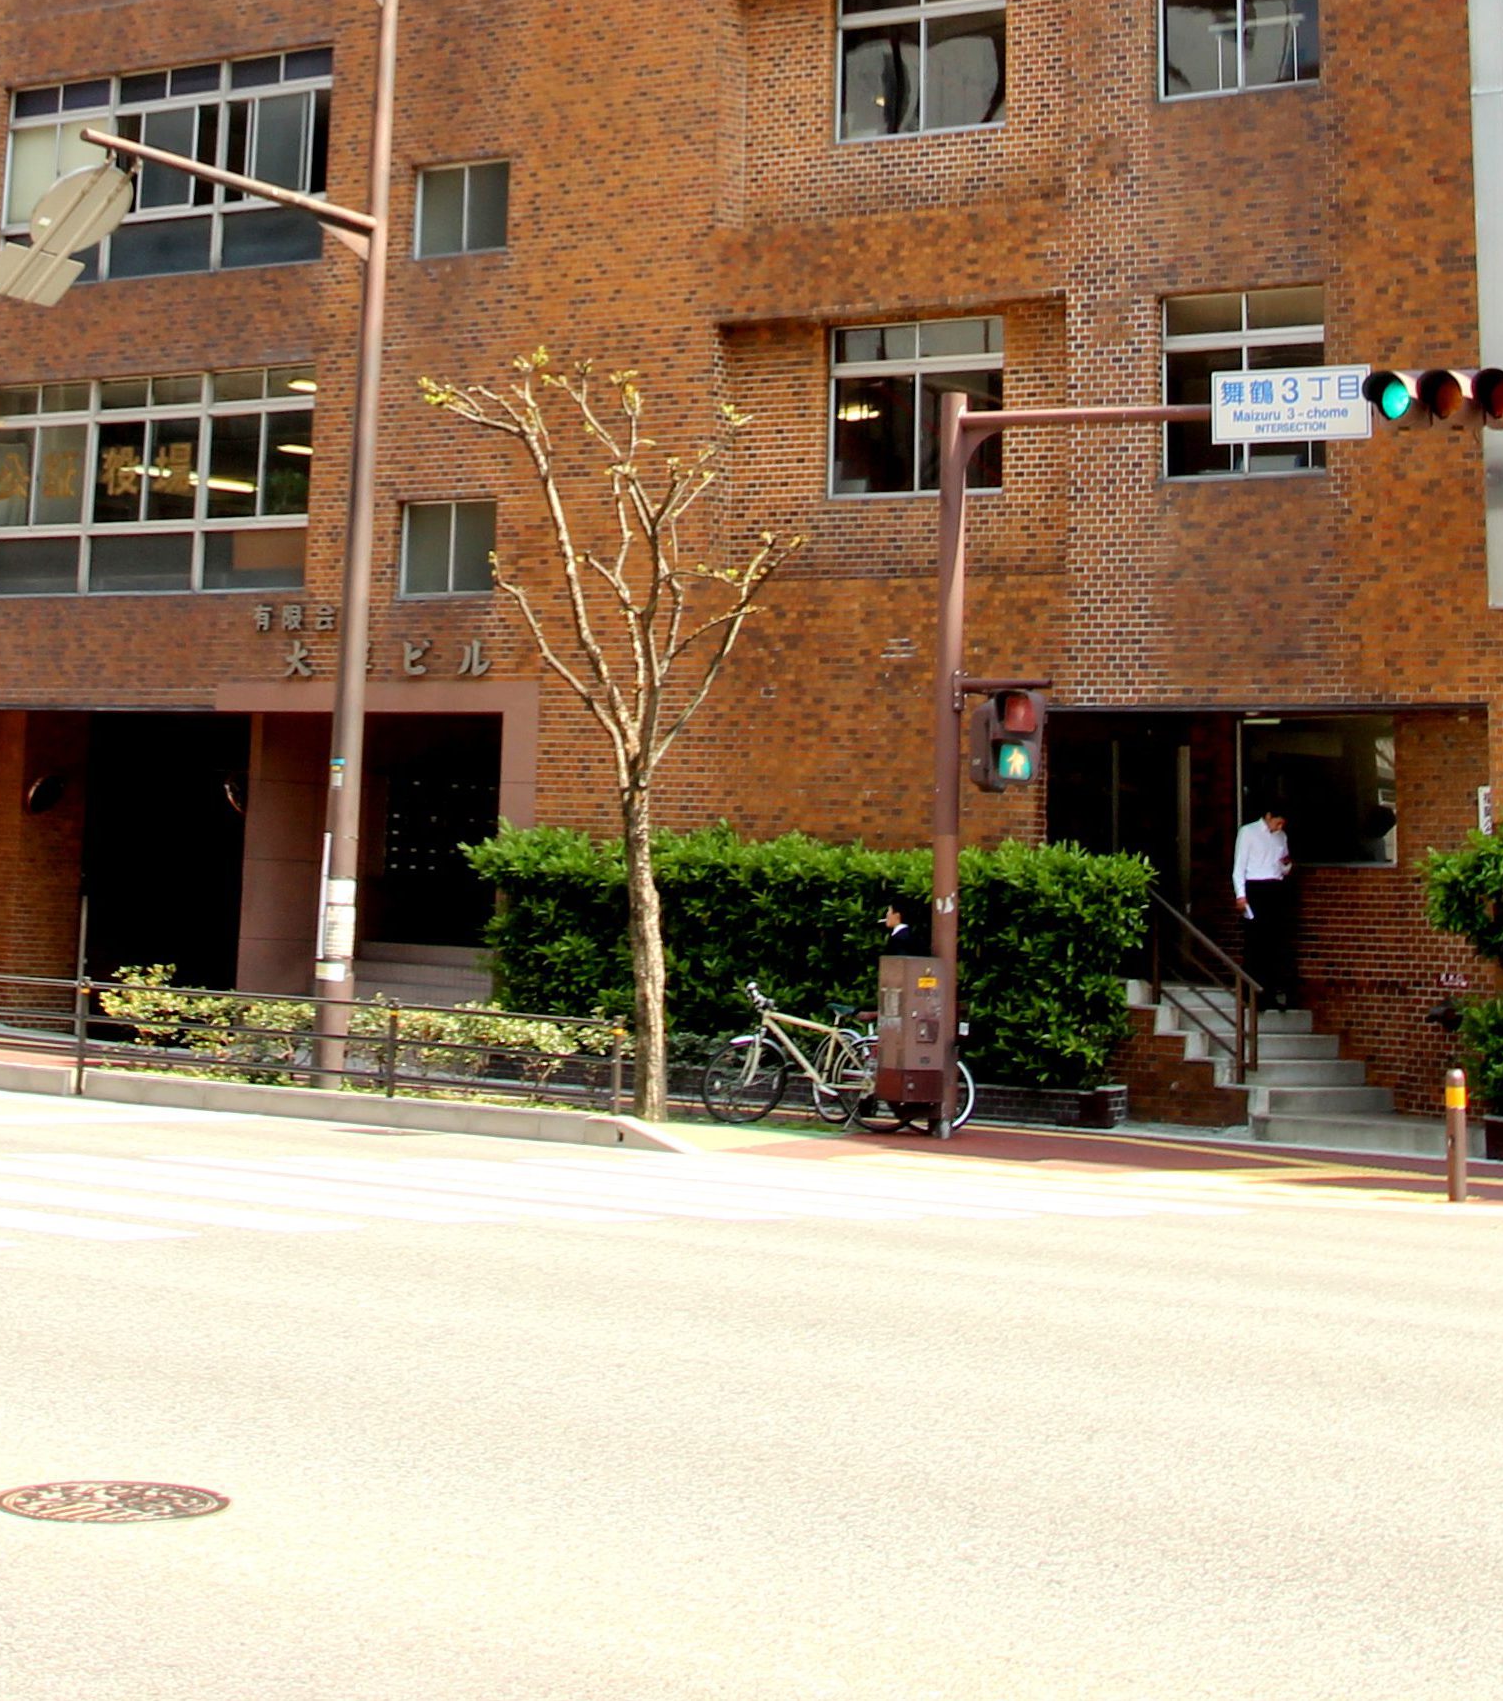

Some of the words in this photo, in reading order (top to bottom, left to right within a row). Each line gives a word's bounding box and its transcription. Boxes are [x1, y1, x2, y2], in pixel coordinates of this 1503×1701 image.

[1221, 376, 1360, 406] 舞鶴3丁目
[1232, 409, 1282, 423] Maizuru
[1254, 421, 1327, 434] INTERSECTION
[253, 604, 337, 632] 有限会
[284, 639, 492, 677] 大ビル
